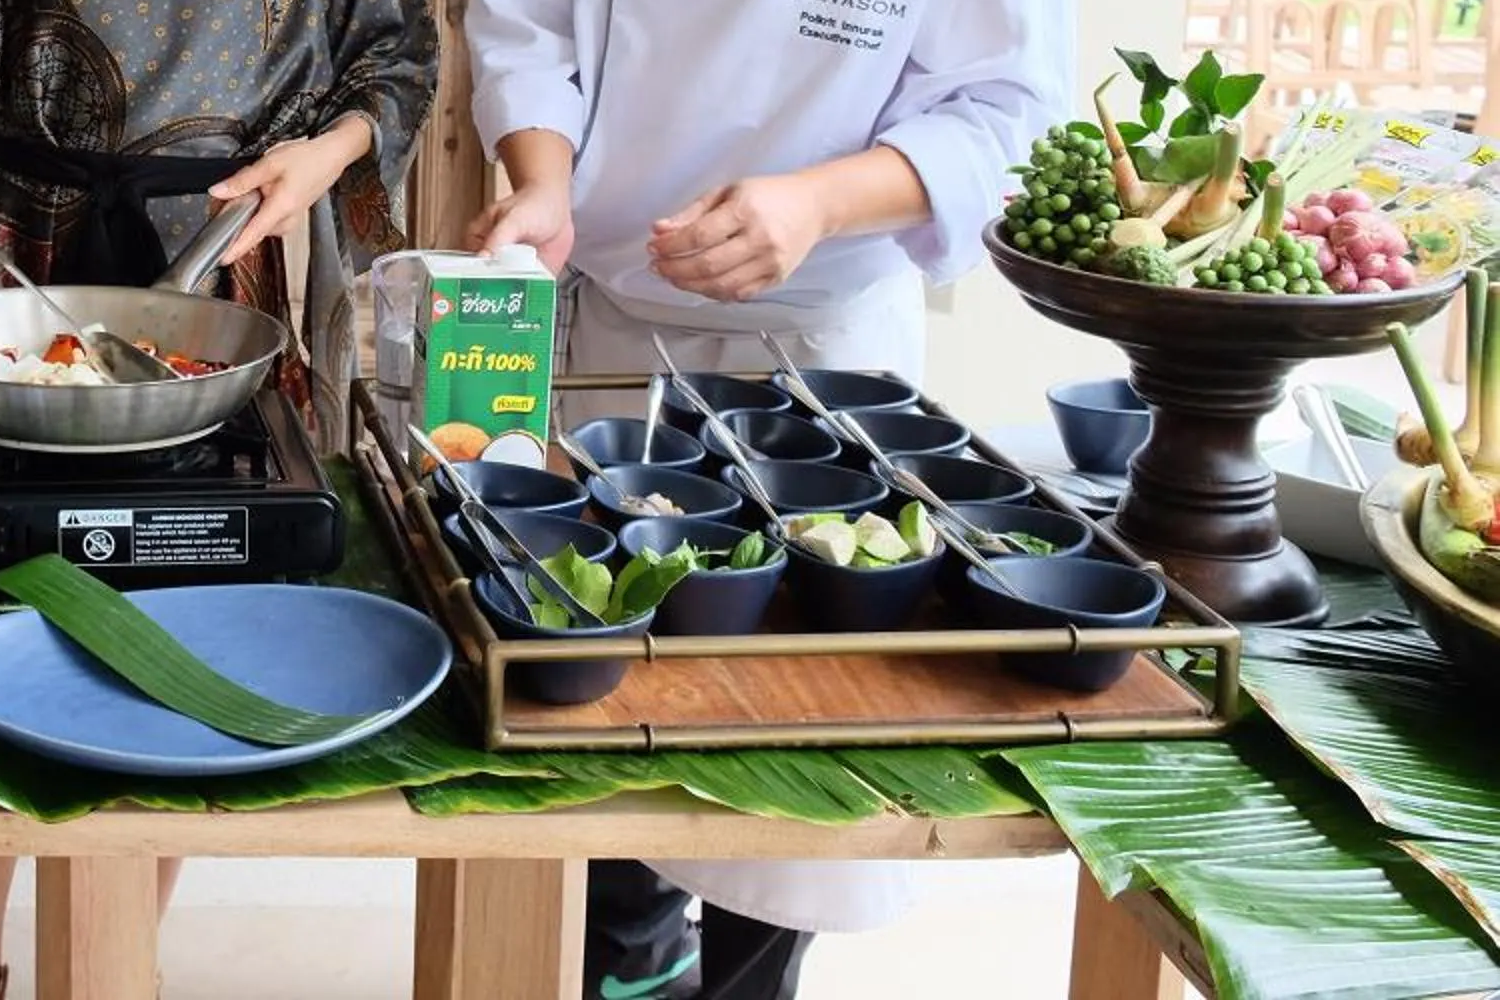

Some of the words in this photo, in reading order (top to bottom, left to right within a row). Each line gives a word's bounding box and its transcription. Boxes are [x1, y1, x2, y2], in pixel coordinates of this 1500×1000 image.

[799, 25, 852, 45] Executive
[854, 37, 882, 50] Chef
[486, 352, 537, 372] 100%
[83, 513, 127, 523] DANGER
